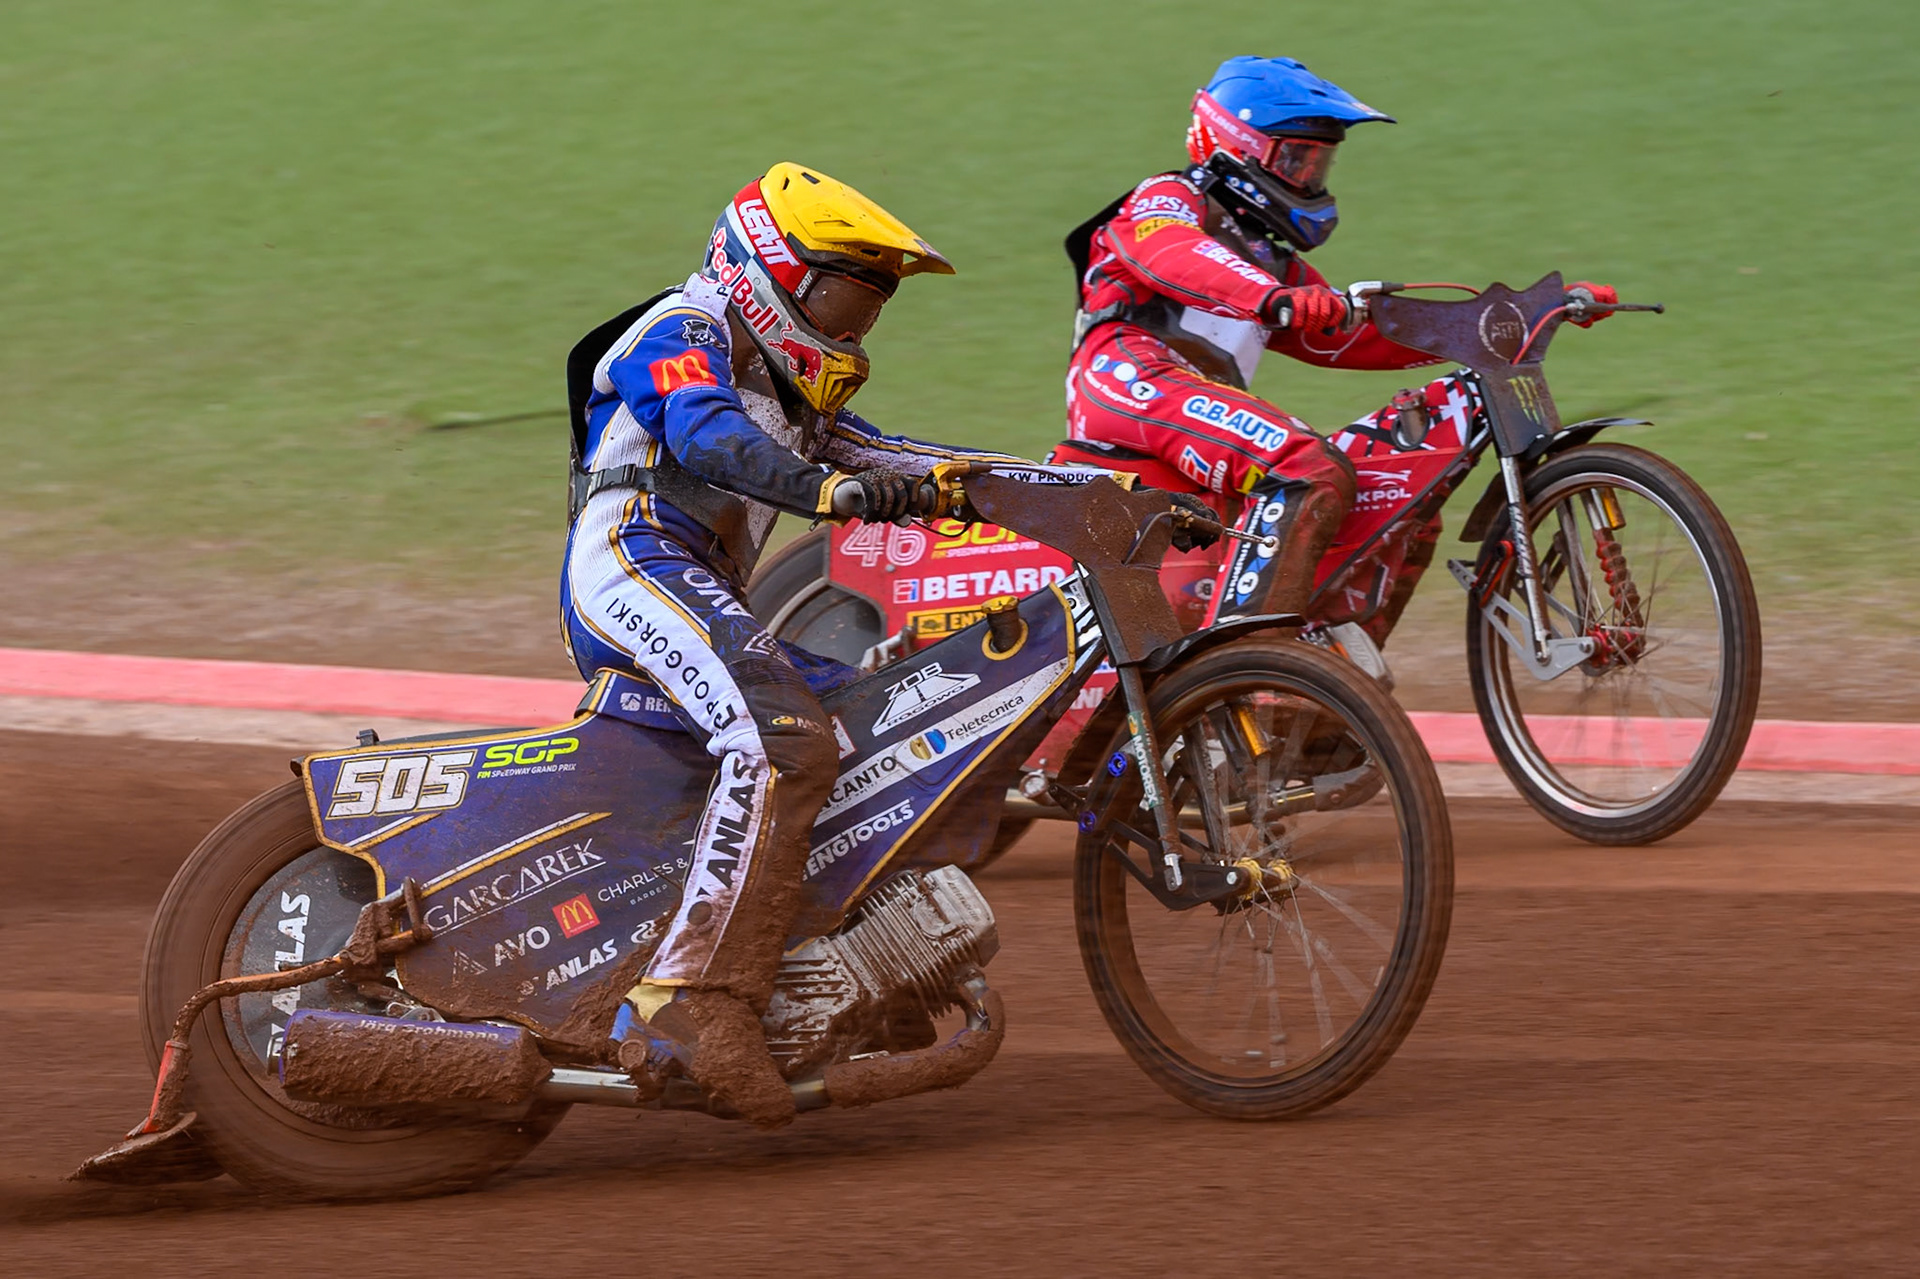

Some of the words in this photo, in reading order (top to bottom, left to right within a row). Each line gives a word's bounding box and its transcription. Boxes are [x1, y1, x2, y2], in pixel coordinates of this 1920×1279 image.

[739, 198, 800, 267] LEATT
[710, 227, 744, 286] Red
[731, 279, 781, 336] Bull
[1008, 472, 1032, 482] KW
[1038, 472, 1094, 482] PRODUC
[840, 516, 927, 567] 46
[922, 566, 1066, 602] BETARD
[884, 662, 943, 700] ZDB
[886, 685, 965, 727] ROGOWO
[945, 695, 1025, 740] Teletecnica
[477, 770, 491, 779] FIM
[491, 766, 532, 778] SPEEDWAY
[531, 764, 558, 774] GRAND
[558, 763, 576, 772] PRIX
[482, 737, 579, 769] SGP
[1132, 734, 1159, 804] MOTOREX
[327, 749, 477, 819] 505
[706, 757, 763, 891] ANLAS
[803, 799, 915, 881] ENGTOOLS
[424, 837, 603, 932] GARCAREK
[598, 862, 674, 902] CHARLES
[272, 890, 311, 1016] ALAS
[495, 925, 550, 967] AVO
[546, 938, 618, 991] ANLAS
